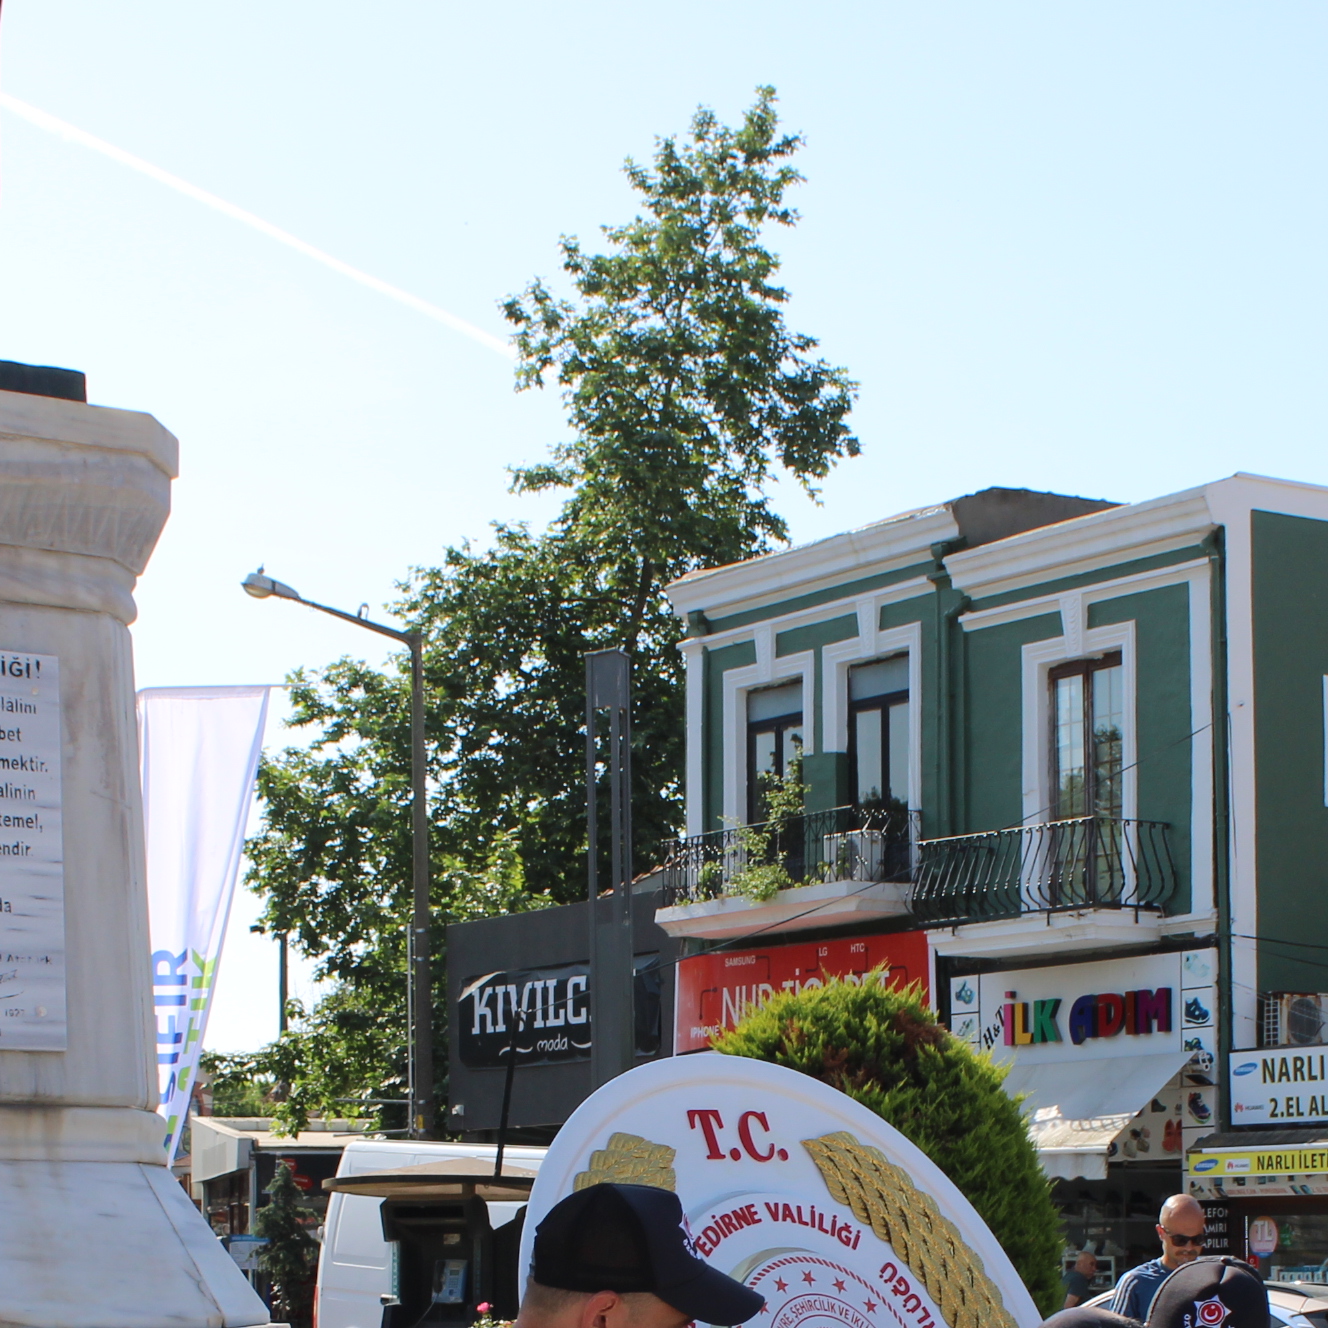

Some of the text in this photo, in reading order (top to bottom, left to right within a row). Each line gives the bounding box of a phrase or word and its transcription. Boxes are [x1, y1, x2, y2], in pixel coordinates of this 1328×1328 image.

[818, 947, 828, 957] LG
[850, 943, 865, 953] HTC
[6, 954, 52, 965] Attrk
[725, 955, 756, 968] SAMSUNG
[472, 975, 592, 1035] KIVILC
[1004, 991, 1063, 1046] İLK
[1069, 987, 1172, 1046] ADIM
[690, 1025, 720, 1038] IPHONE
[537, 1033, 568, 1051] moda
[1262, 1055, 1326, 1084] NARLI
[1269, 1096, 1305, 1118] 2.EL
[687, 1108, 789, 1163] T.C.
[1257, 1154, 1295, 1172] NARLI
[695, 1203, 762, 1257] EDİRNE
[765, 1202, 862, 1250] VALİLİĞİ
[790, 1296, 836, 1321] ŞEHİRCİLİK
[838, 1304, 850, 1320] VE
